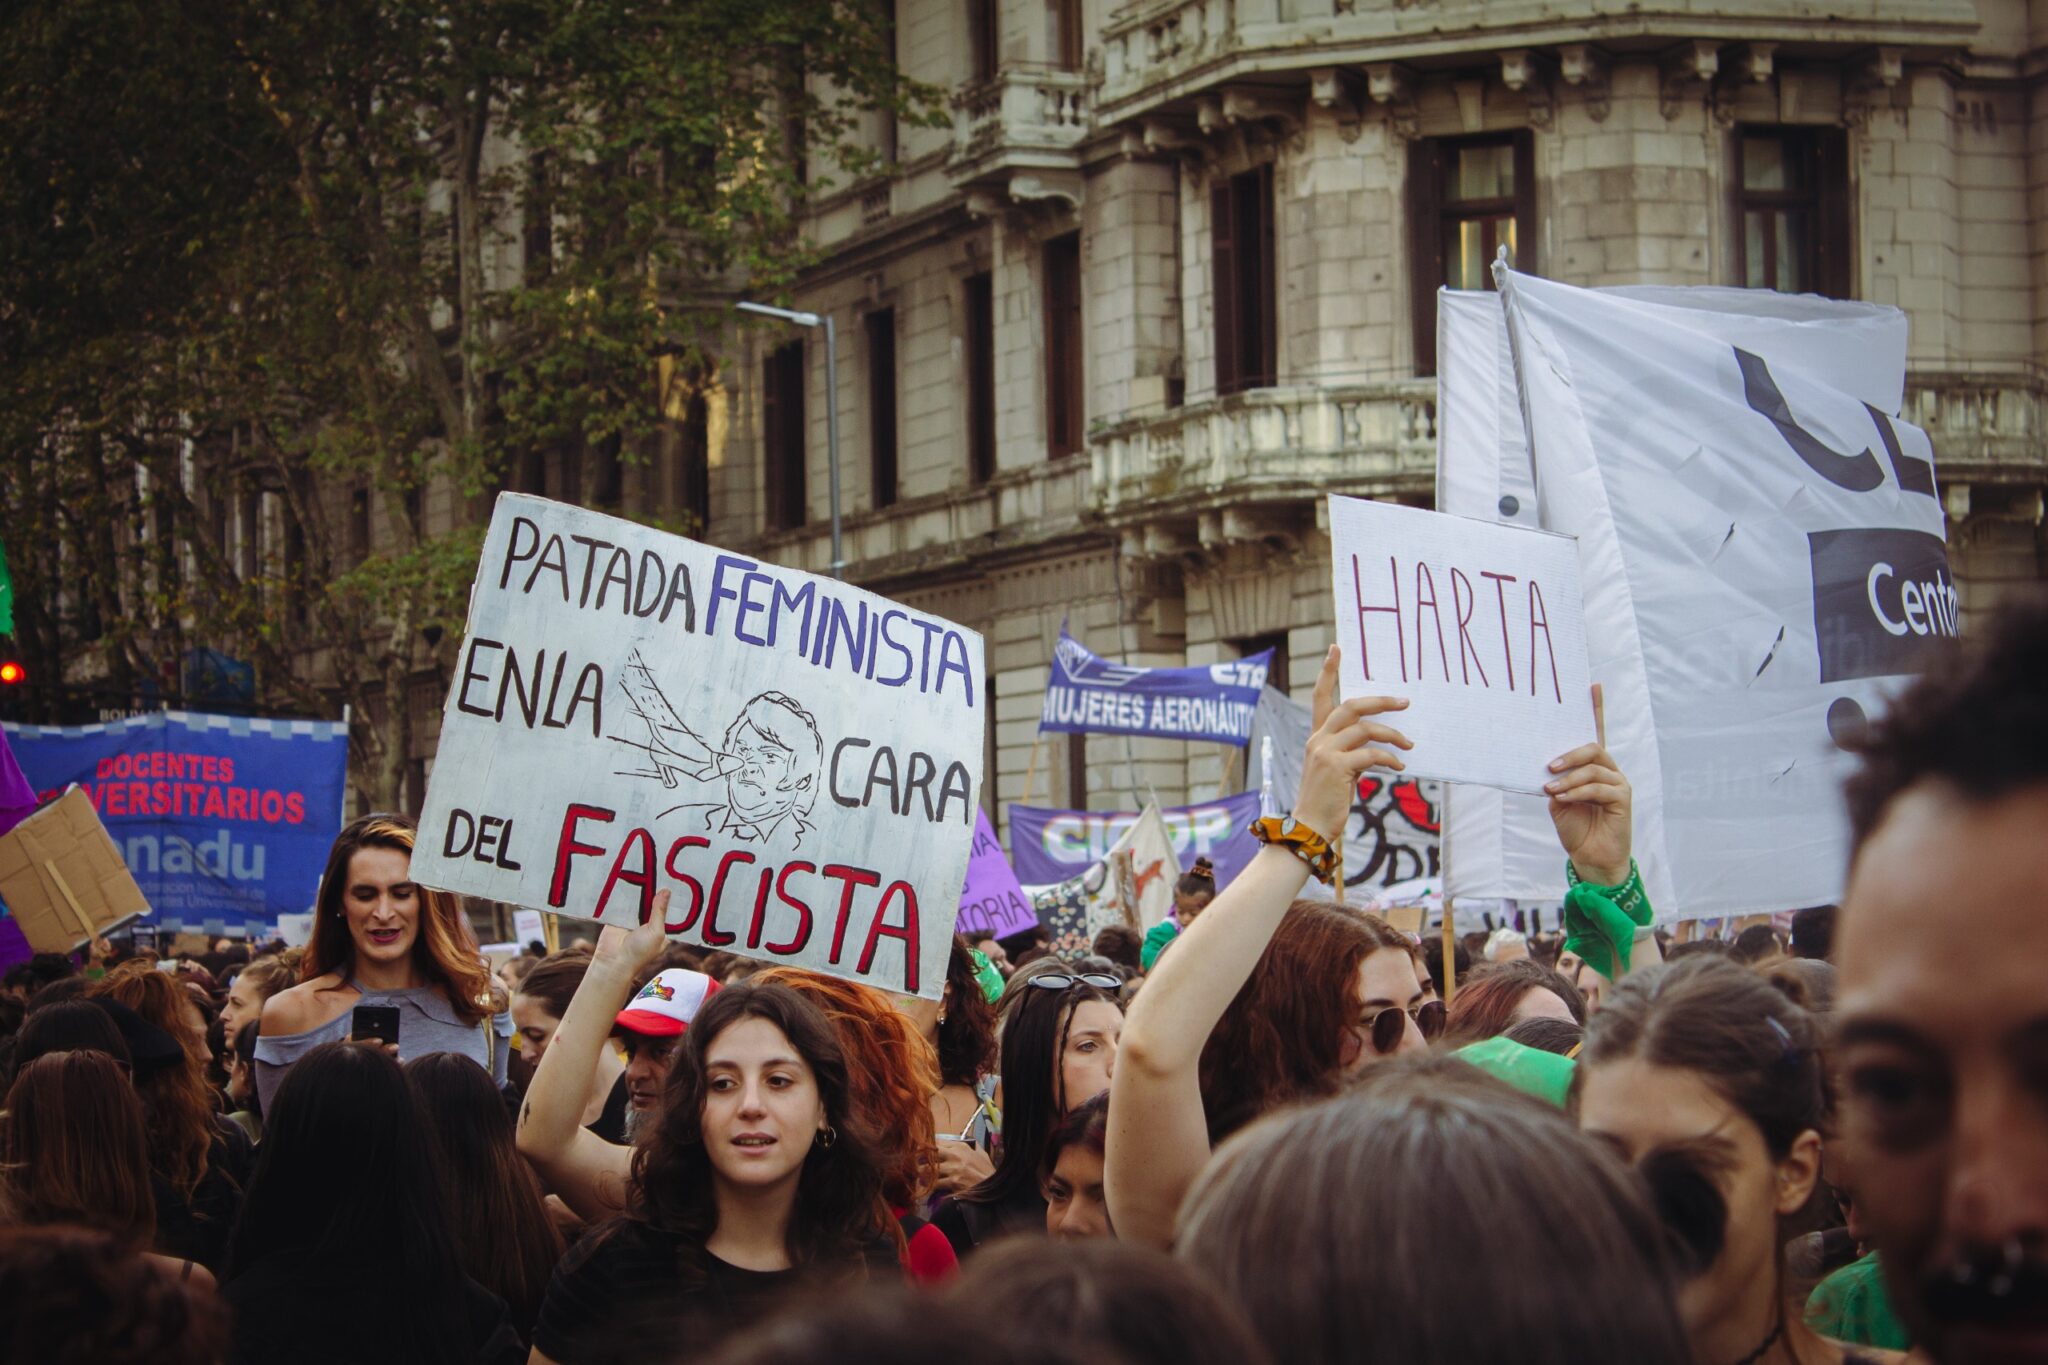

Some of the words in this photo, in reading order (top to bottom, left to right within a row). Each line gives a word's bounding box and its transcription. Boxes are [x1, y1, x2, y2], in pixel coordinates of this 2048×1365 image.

[500, 517, 696, 634] PATADA
[705, 554, 974, 708] FEMINISTA
[1352, 553, 1562, 704] HARTA
[1867, 561, 1960, 640] Centr
[38, 782, 305, 824] VERSITARIOS
[96, 752, 235, 783] DOCENTES
[829, 737, 972, 825] CARA
[112, 829, 265, 880] nadu
[442, 808, 521, 871] DEL
[547, 803, 920, 992] FASCISTA
